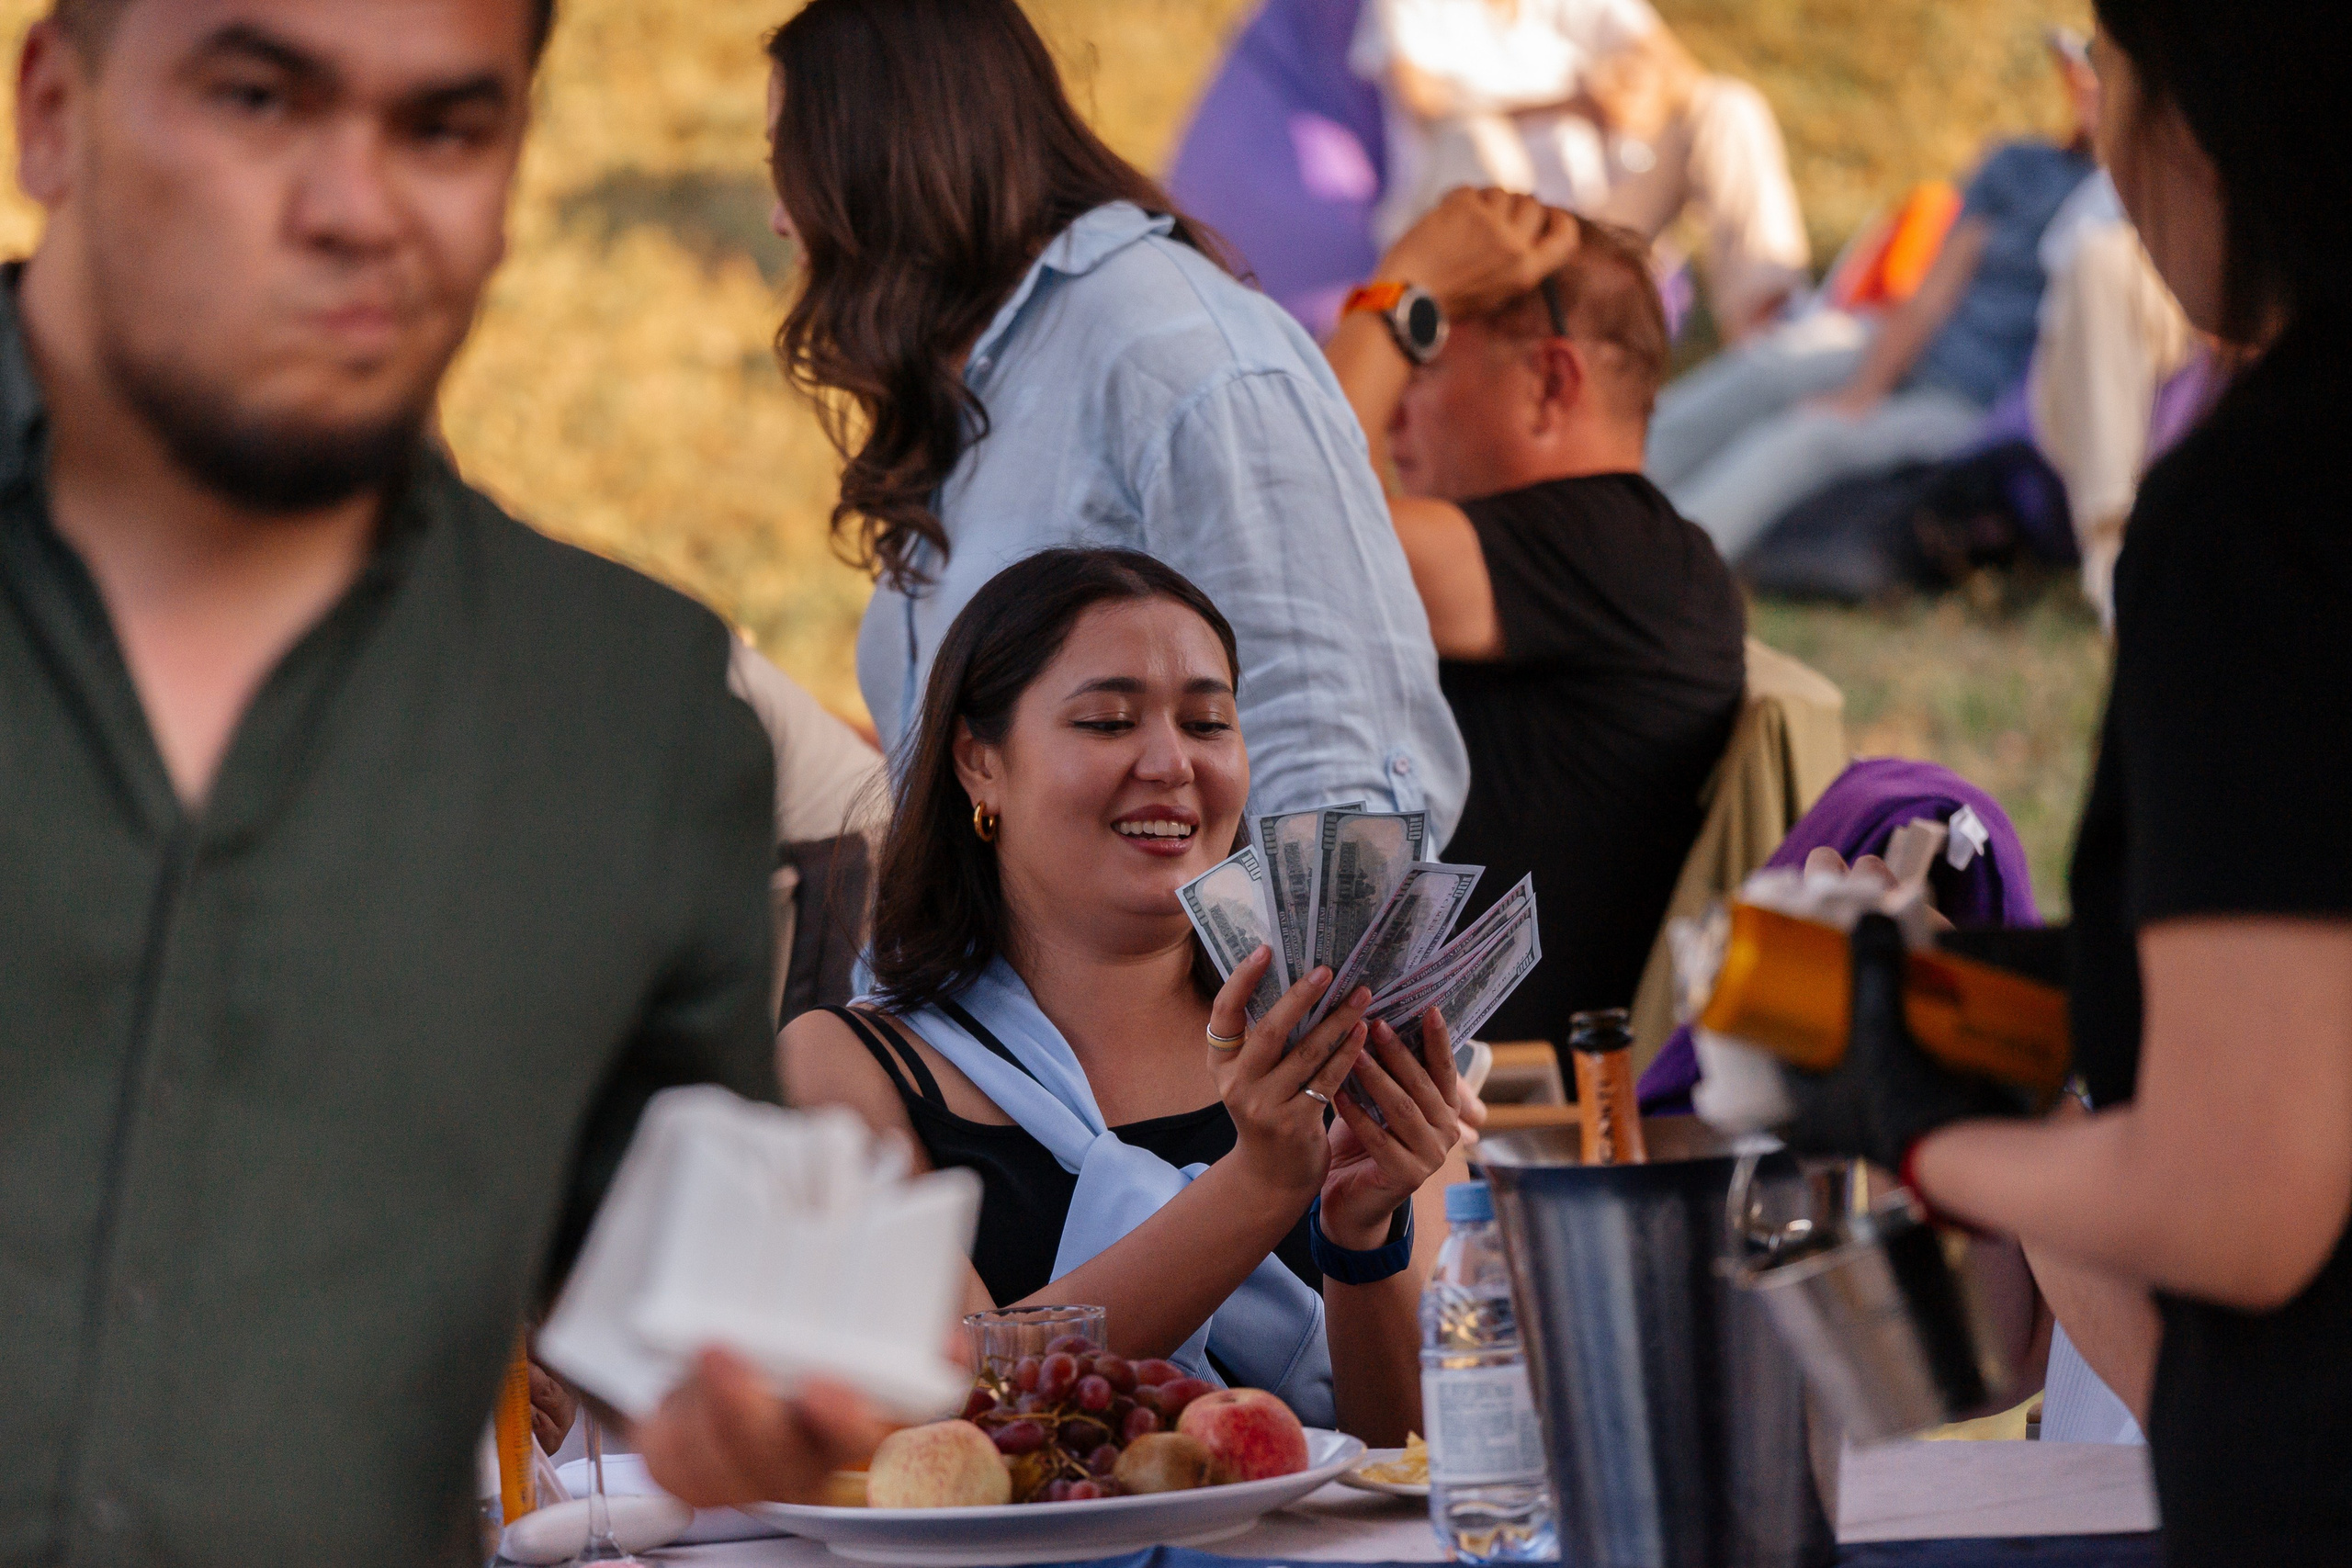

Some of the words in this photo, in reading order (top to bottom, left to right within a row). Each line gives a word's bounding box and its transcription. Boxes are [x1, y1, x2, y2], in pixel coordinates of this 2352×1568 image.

[1408, 816, 1423, 840] 100
[1241, 852, 1261, 881] 100
[1453, 876, 1473, 897] 100
[1282, 926, 1294, 964] HUNDRED
[1516, 953, 1534, 976] 100
